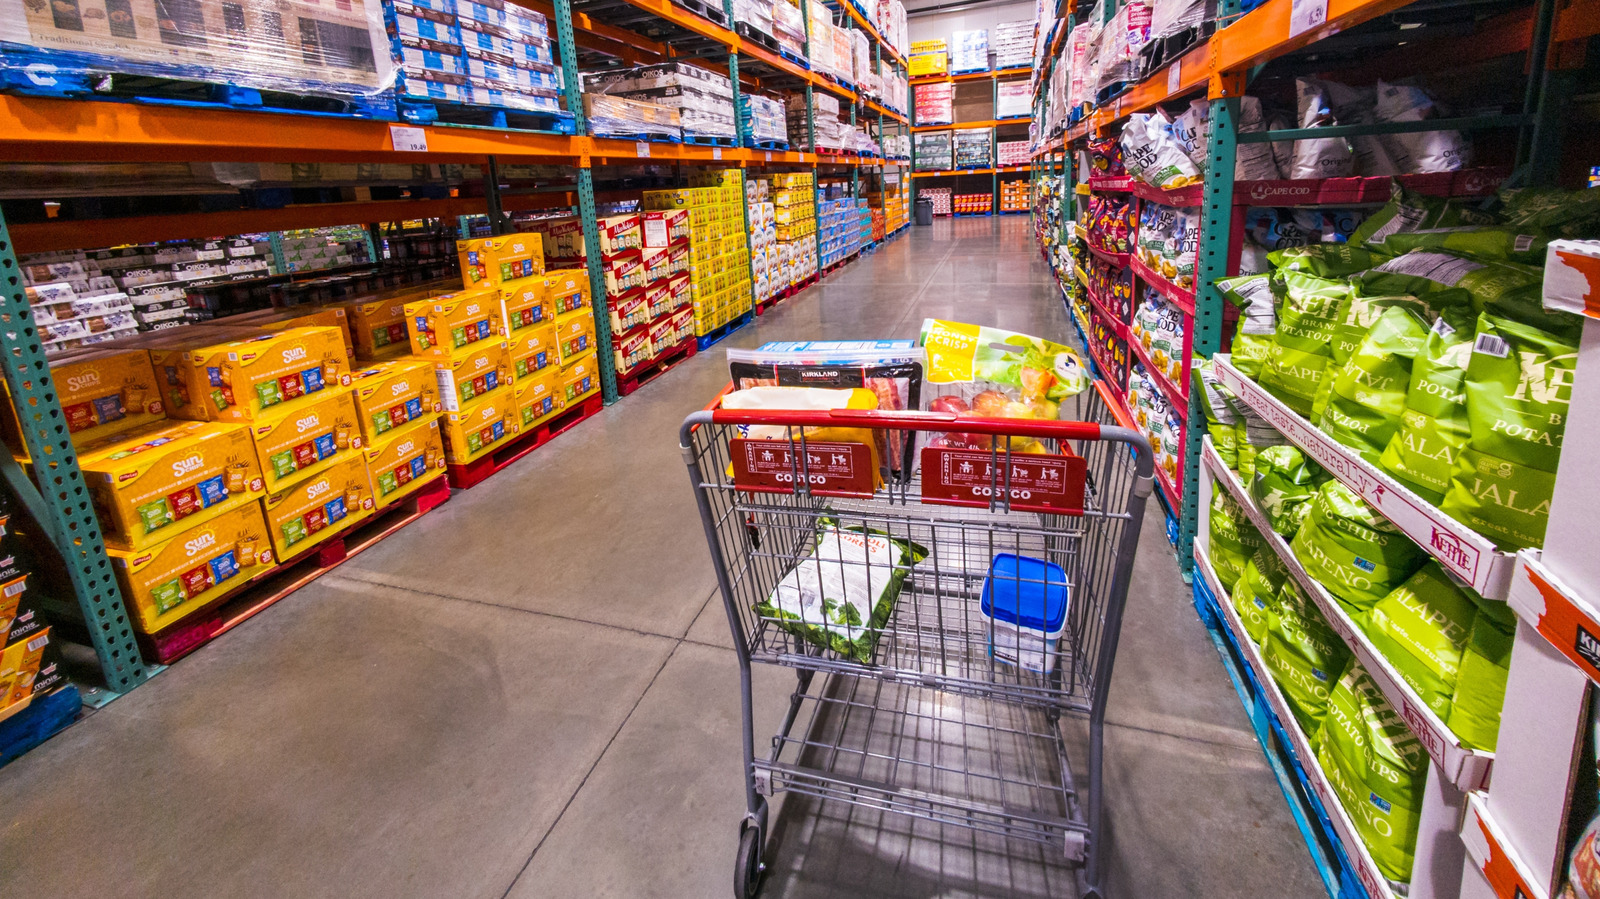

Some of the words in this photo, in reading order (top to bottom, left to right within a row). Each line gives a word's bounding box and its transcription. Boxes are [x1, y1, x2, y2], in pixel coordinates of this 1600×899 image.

[1264, 188, 1288, 197] CAPE
[1288, 186, 1310, 195] COD
[935, 335, 969, 350] CRISP
[282, 346, 307, 364] Sun
[66, 373, 101, 392] Sun
[296, 414, 319, 433] Sun
[172, 455, 204, 478] Sun
[307, 480, 330, 500] Sun
[1469, 477, 1552, 517] JALA
[1336, 518, 1390, 547] CHIPS
[184, 532, 216, 557] Sun
[1428, 524, 1472, 574] KETTLE
[10, 622, 38, 638] minis
[33, 673, 59, 691] minis
